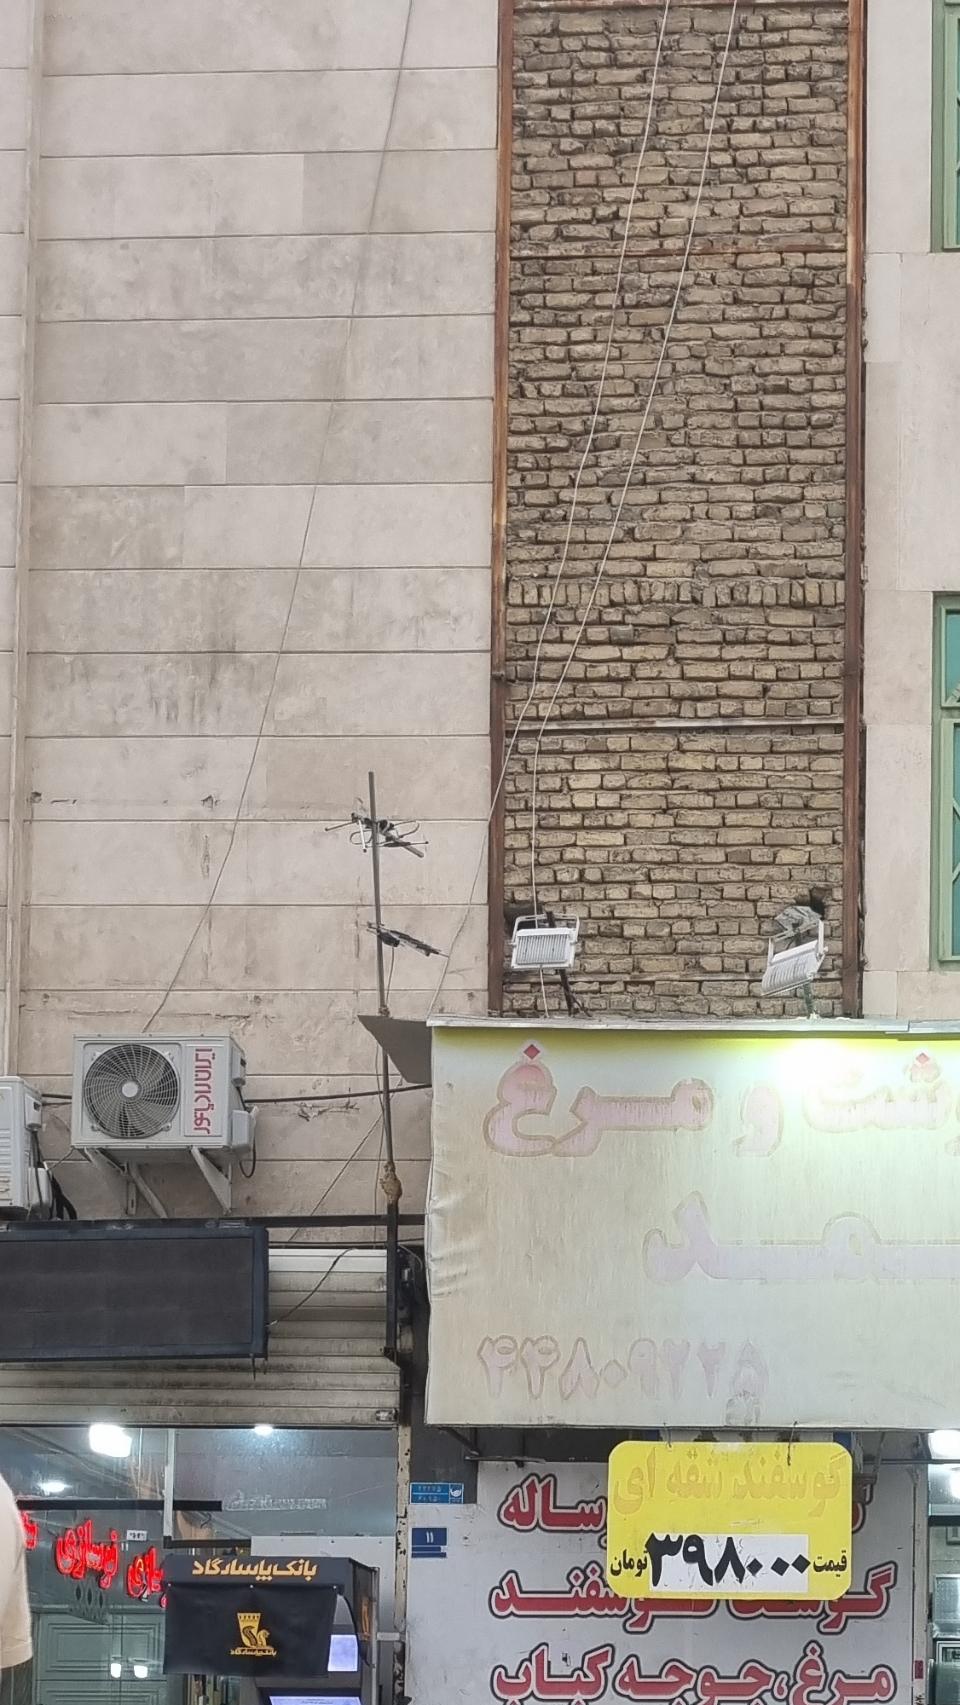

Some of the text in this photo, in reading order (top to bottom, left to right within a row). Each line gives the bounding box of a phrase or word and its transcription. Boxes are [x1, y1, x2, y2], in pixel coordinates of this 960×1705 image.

[482, 1041, 715, 1158] مرغ
[733, 1083, 784, 1158] و
[498, 1473, 608, 1542] ساله
[733, 1449, 848, 1518] گوسفند
[192, 1557, 318, 1581] بانک پاسارگاد
[610, 1548, 649, 1577] تومان
[812, 1549, 848, 1578] قیمت
